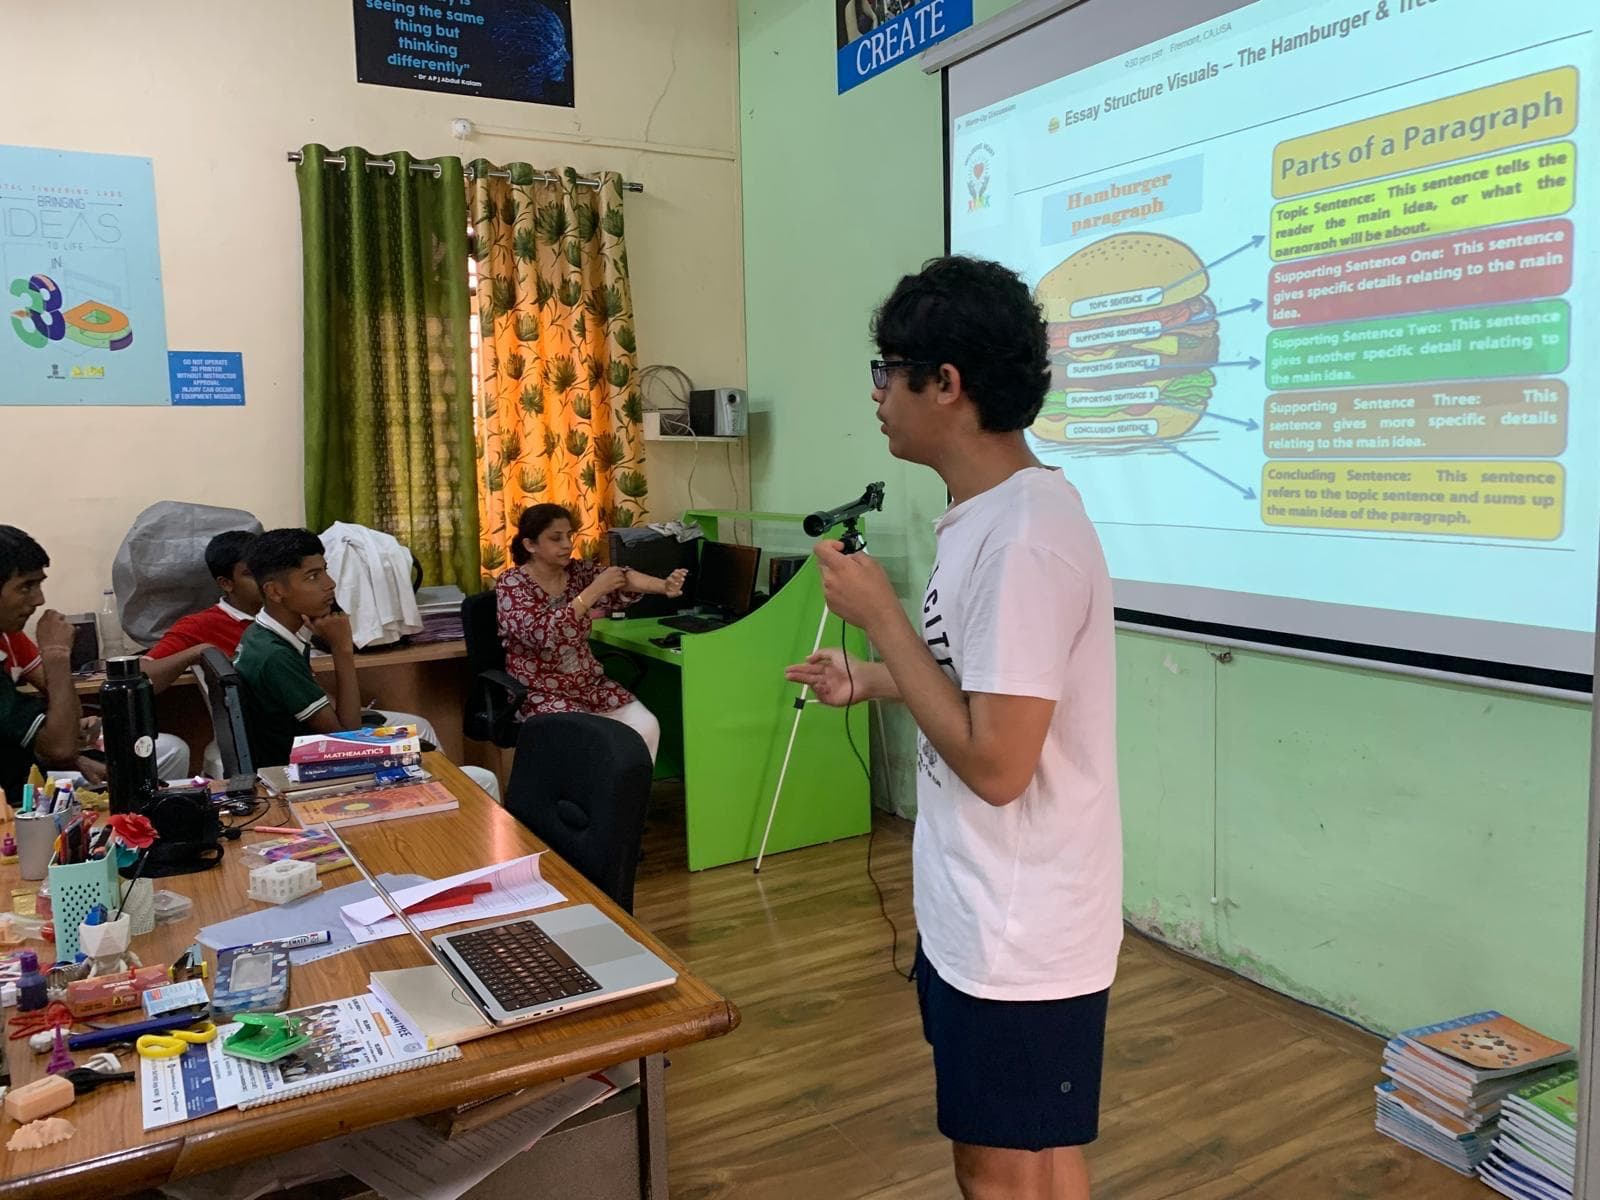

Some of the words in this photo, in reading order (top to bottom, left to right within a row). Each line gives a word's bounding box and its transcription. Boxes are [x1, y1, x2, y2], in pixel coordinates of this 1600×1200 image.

[366, 0, 416, 17] seeing
[419, 6, 442, 19] the
[446, 9, 485, 25] same
[394, 18, 432, 37] thing
[435, 23, 460, 39] but
[856, 0, 945, 75] CREATE
[399, 37, 458, 58] thinking
[387, 54, 470, 77] differently"
[1065, 103, 1100, 127] Essay
[1104, 83, 1163, 114] Structure
[1167, 62, 1219, 92] Visuals
[1237, 47, 1266, 68] The
[1271, 9, 1370, 57] Hamburger
[1375, 0, 1390, 21] &
[1281, 149, 1341, 180] Parts
[1348, 135, 1375, 163] of
[1381, 138, 1395, 156] a
[1404, 91, 1563, 150] Paragraph
[1066, 173, 1172, 211] Hamburger
[1277, 206, 1309, 222] Topic
[1314, 192, 1376, 214] Sentence:
[1388, 184, 1417, 198] This
[1422, 168, 1489, 192] sentence
[1495, 158, 1530, 176] tells
[1538, 152, 1567, 168] the
[37, 195, 86, 209] BRINGING
[1275, 223, 1314, 239] reader
[1325, 216, 1345, 230] the
[1357, 208, 1390, 225] main
[1403, 201, 1437, 216] idea,
[1451, 193, 1468, 206] or
[1481, 181, 1522, 201] what
[1537, 174, 1566, 190] the
[3, 208, 122, 243] IDEAS
[1071, 197, 1164, 236] paragraph
[63, 242, 83, 251] LIFE
[1274, 239, 1337, 257] paragraph
[1340, 231, 1363, 246] will
[1365, 228, 1381, 241] be
[1385, 222, 1431, 238] about.
[51, 256, 62, 269] IN
[1274, 265, 1342, 286] Supporting
[1345, 254, 1406, 273] Sentence
[1410, 248, 1444, 263] One:
[1452, 241, 1484, 257] This
[1489, 229, 1565, 249] sentence
[1273, 289, 1304, 305] gives
[1307, 280, 1354, 300] specific
[1357, 275, 1401, 292] details
[1406, 266, 1462, 286] relating
[1467, 262, 1483, 276] to
[1488, 258, 1515, 274] the
[1520, 252, 1563, 269] main
[1089, 299, 1108, 310] TOPIC
[1110, 295, 1143, 307] SENTENCE
[1272, 307, 1301, 321] idea.
[1075, 331, 1115, 343] SUPPORTING
[1271, 334, 1339, 352] Supporting
[1343, 327, 1404, 344] Sentence
[1408, 323, 1441, 337] Two:
[1450, 317, 1481, 332] This
[1486, 311, 1561, 330] sentence
[1271, 355, 1301, 369] gives
[1307, 349, 1356, 365] another
[1362, 344, 1413, 361] specific
[1420, 340, 1462, 355] detail
[1469, 333, 1533, 352] relating
[1541, 333, 1560, 346] to
[1072, 362, 1113, 373] SUPPORTING
[1271, 372, 1290, 385] the
[1293, 370, 1322, 383] main
[1324, 368, 1355, 381] idea.
[1071, 394, 1112, 403] SUPPORTING
[1114, 391, 1147, 401] SENTENCE
[1270, 400, 1337, 415] Supporting
[1353, 396, 1415, 411] Sentence
[1432, 393, 1481, 407] Three:
[1522, 389, 1558, 403] This
[1073, 422, 1115, 434] CONCLUSION
[1117, 424, 1149, 432] SENTENCE
[1269, 419, 1322, 432] sentence
[1333, 417, 1367, 432] gives
[1380, 416, 1415, 429] more
[1428, 412, 1486, 429] specific
[1501, 411, 1557, 425] details
[1269, 436, 1314, 452] relating
[1317, 436, 1330, 449] to
[1333, 436, 1353, 449] the
[1356, 435, 1390, 448] main
[1392, 435, 1426, 448] idea.
[1268, 468, 1336, 483] Concluding
[1347, 469, 1411, 482] Sentence:
[1436, 469, 1467, 483] This
[1481, 471, 1556, 485] sentence
[1267, 486, 1300, 500] refers
[1305, 488, 1318, 500] to
[1321, 488, 1341, 501] the
[1345, 488, 1378, 503] topic
[1383, 489, 1445, 502] sentence
[1450, 491, 1479, 505] and
[1484, 493, 1526, 506] sums
[1532, 494, 1554, 509] up
[1267, 505, 1286, 518] the
[1288, 506, 1318, 518] main
[1320, 507, 1348, 519] idea
[1351, 507, 1364, 520] of
[1367, 508, 1387, 521] the
[1391, 510, 1471, 526] paragraph.
[324, 748, 384, 759] MATHEMATICS
